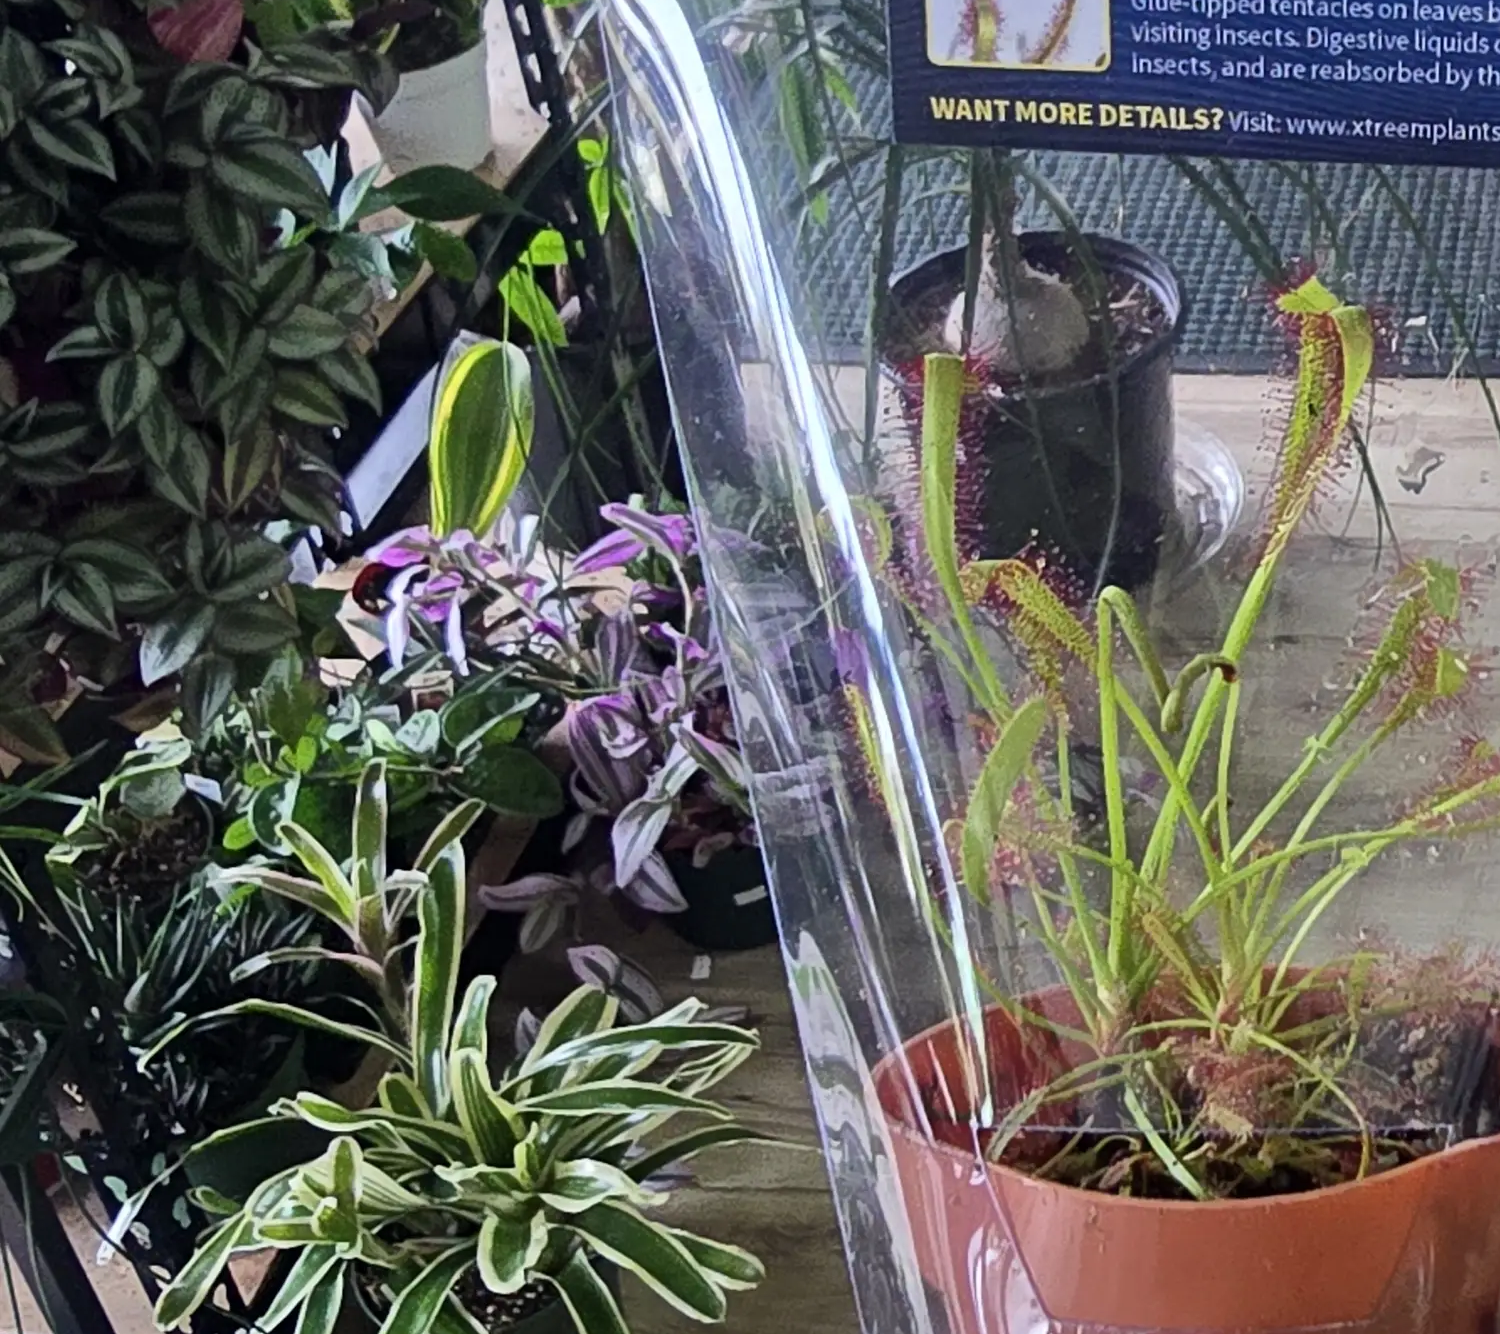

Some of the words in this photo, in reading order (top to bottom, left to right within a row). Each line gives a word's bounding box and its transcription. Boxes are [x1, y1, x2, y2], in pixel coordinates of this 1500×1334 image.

[1378, 1, 1407, 20] on
[1130, 21, 1211, 49] visiting
[1215, 23, 1300, 47] insects.
[1306, 26, 1410, 55] Digestive
[1414, 28, 1490, 58] liquids
[1131, 52, 1217, 82] insects,
[1221, 55, 1265, 78] and
[1269, 60, 1307, 80] are
[1311, 59, 1439, 84] reabsorbed
[1445, 61, 1473, 91] by
[929, 96, 1009, 122] WANT
[1015, 100, 1093, 126] MORE
[1099, 103, 1225, 131] DETAILS?
[1227, 110, 1283, 134] Visit:
